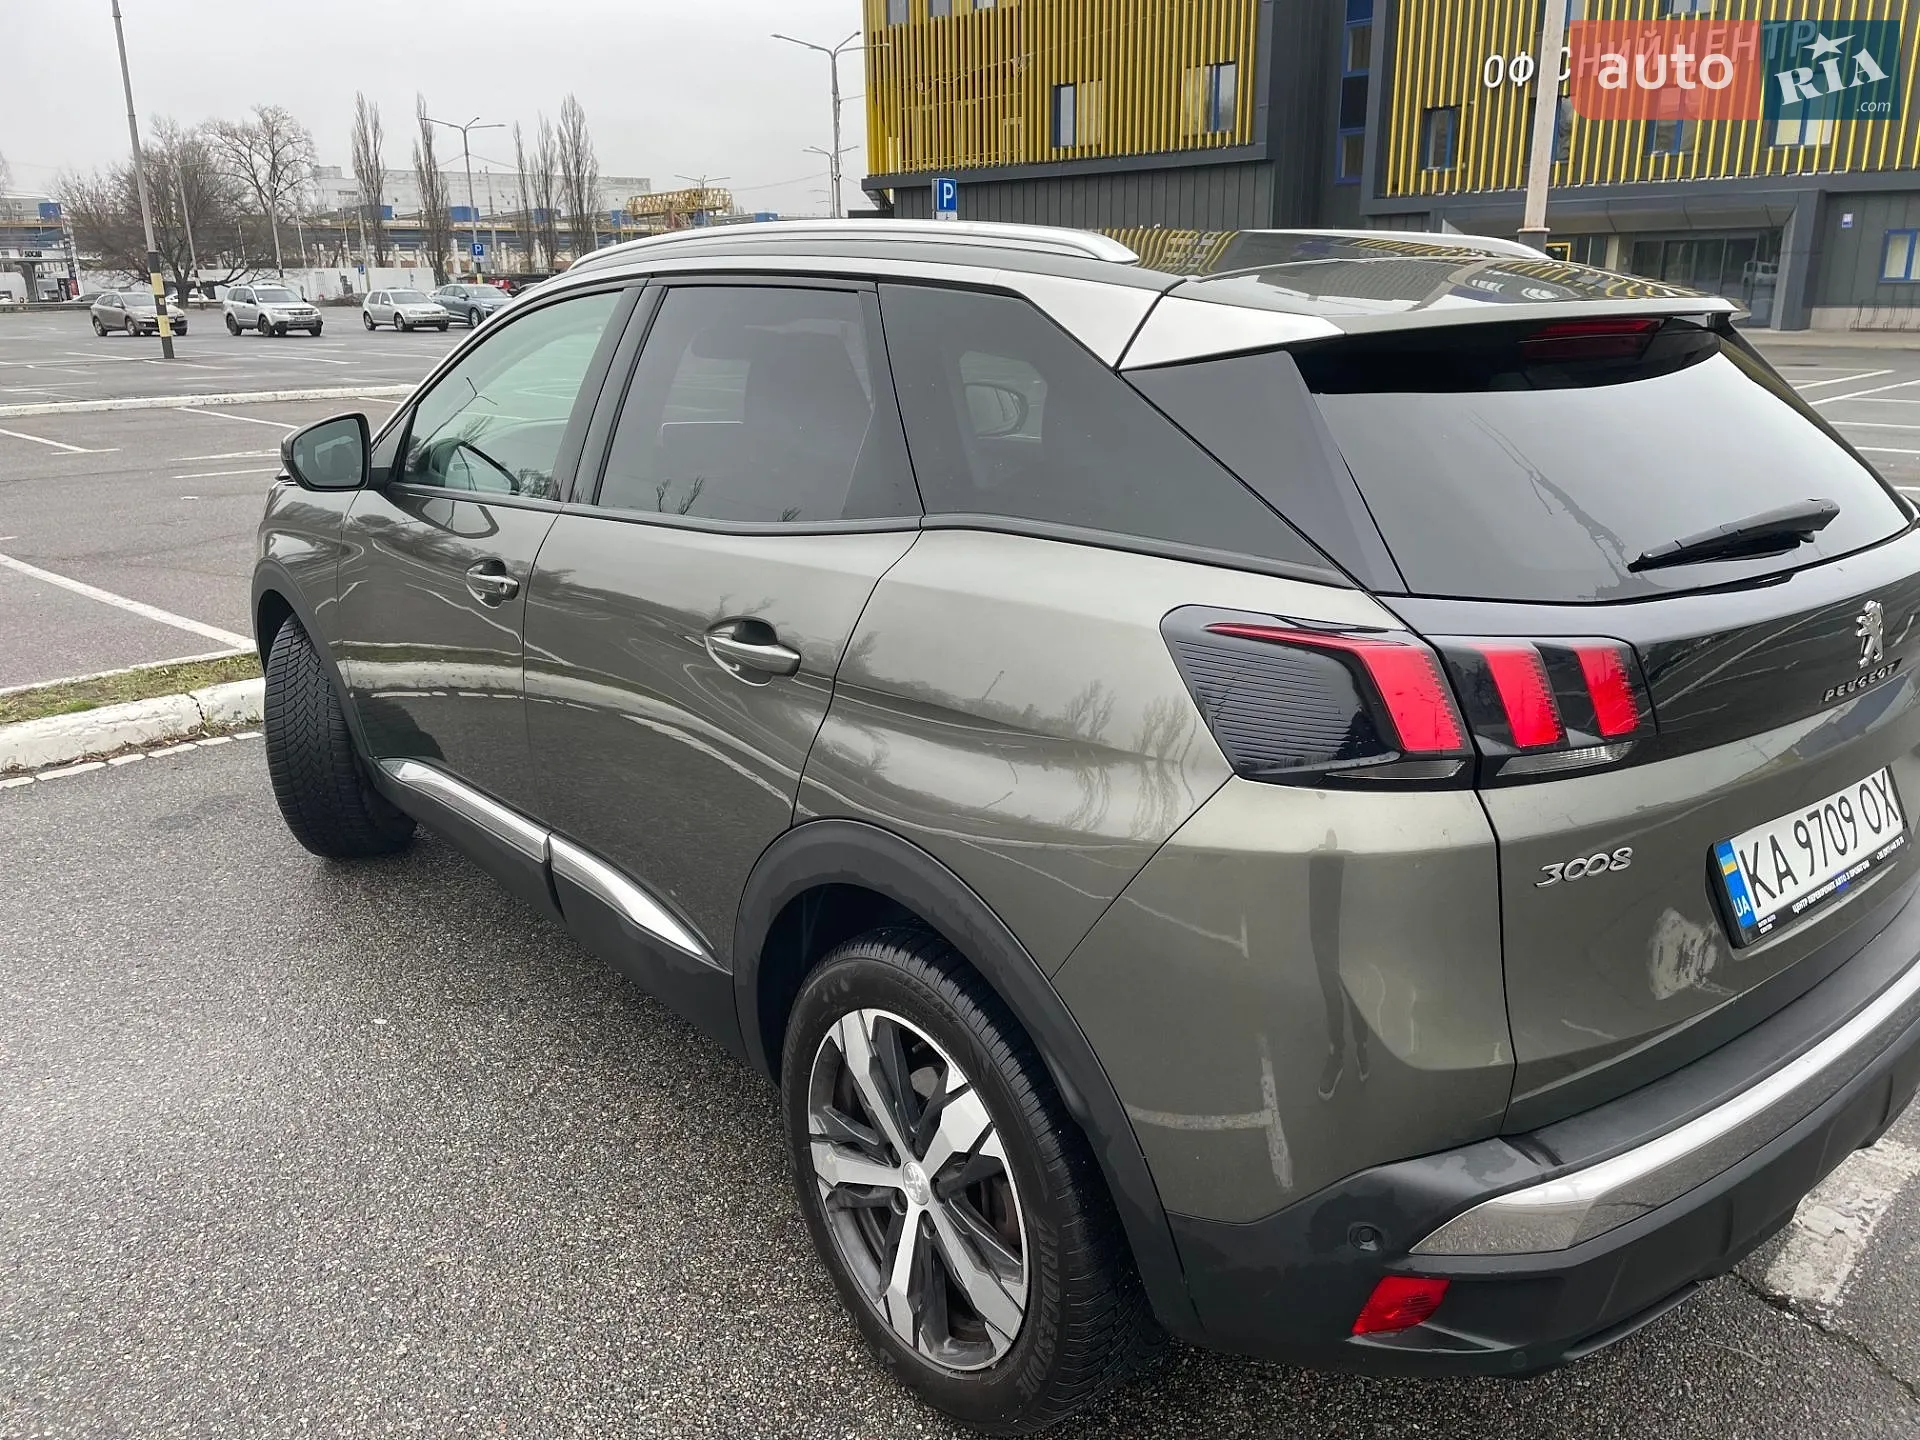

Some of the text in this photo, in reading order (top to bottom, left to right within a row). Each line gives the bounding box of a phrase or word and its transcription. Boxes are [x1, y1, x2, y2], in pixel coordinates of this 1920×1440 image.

[1483, 29, 1661, 89] ОФСНИЙ
[943, 182, 954, 208] P
[1824, 663, 1896, 702] PEUGEOT
[1739, 770, 1899, 908] KA 9709 OX
[1535, 846, 1633, 888] 3008
[1733, 895, 1751, 917] UA
